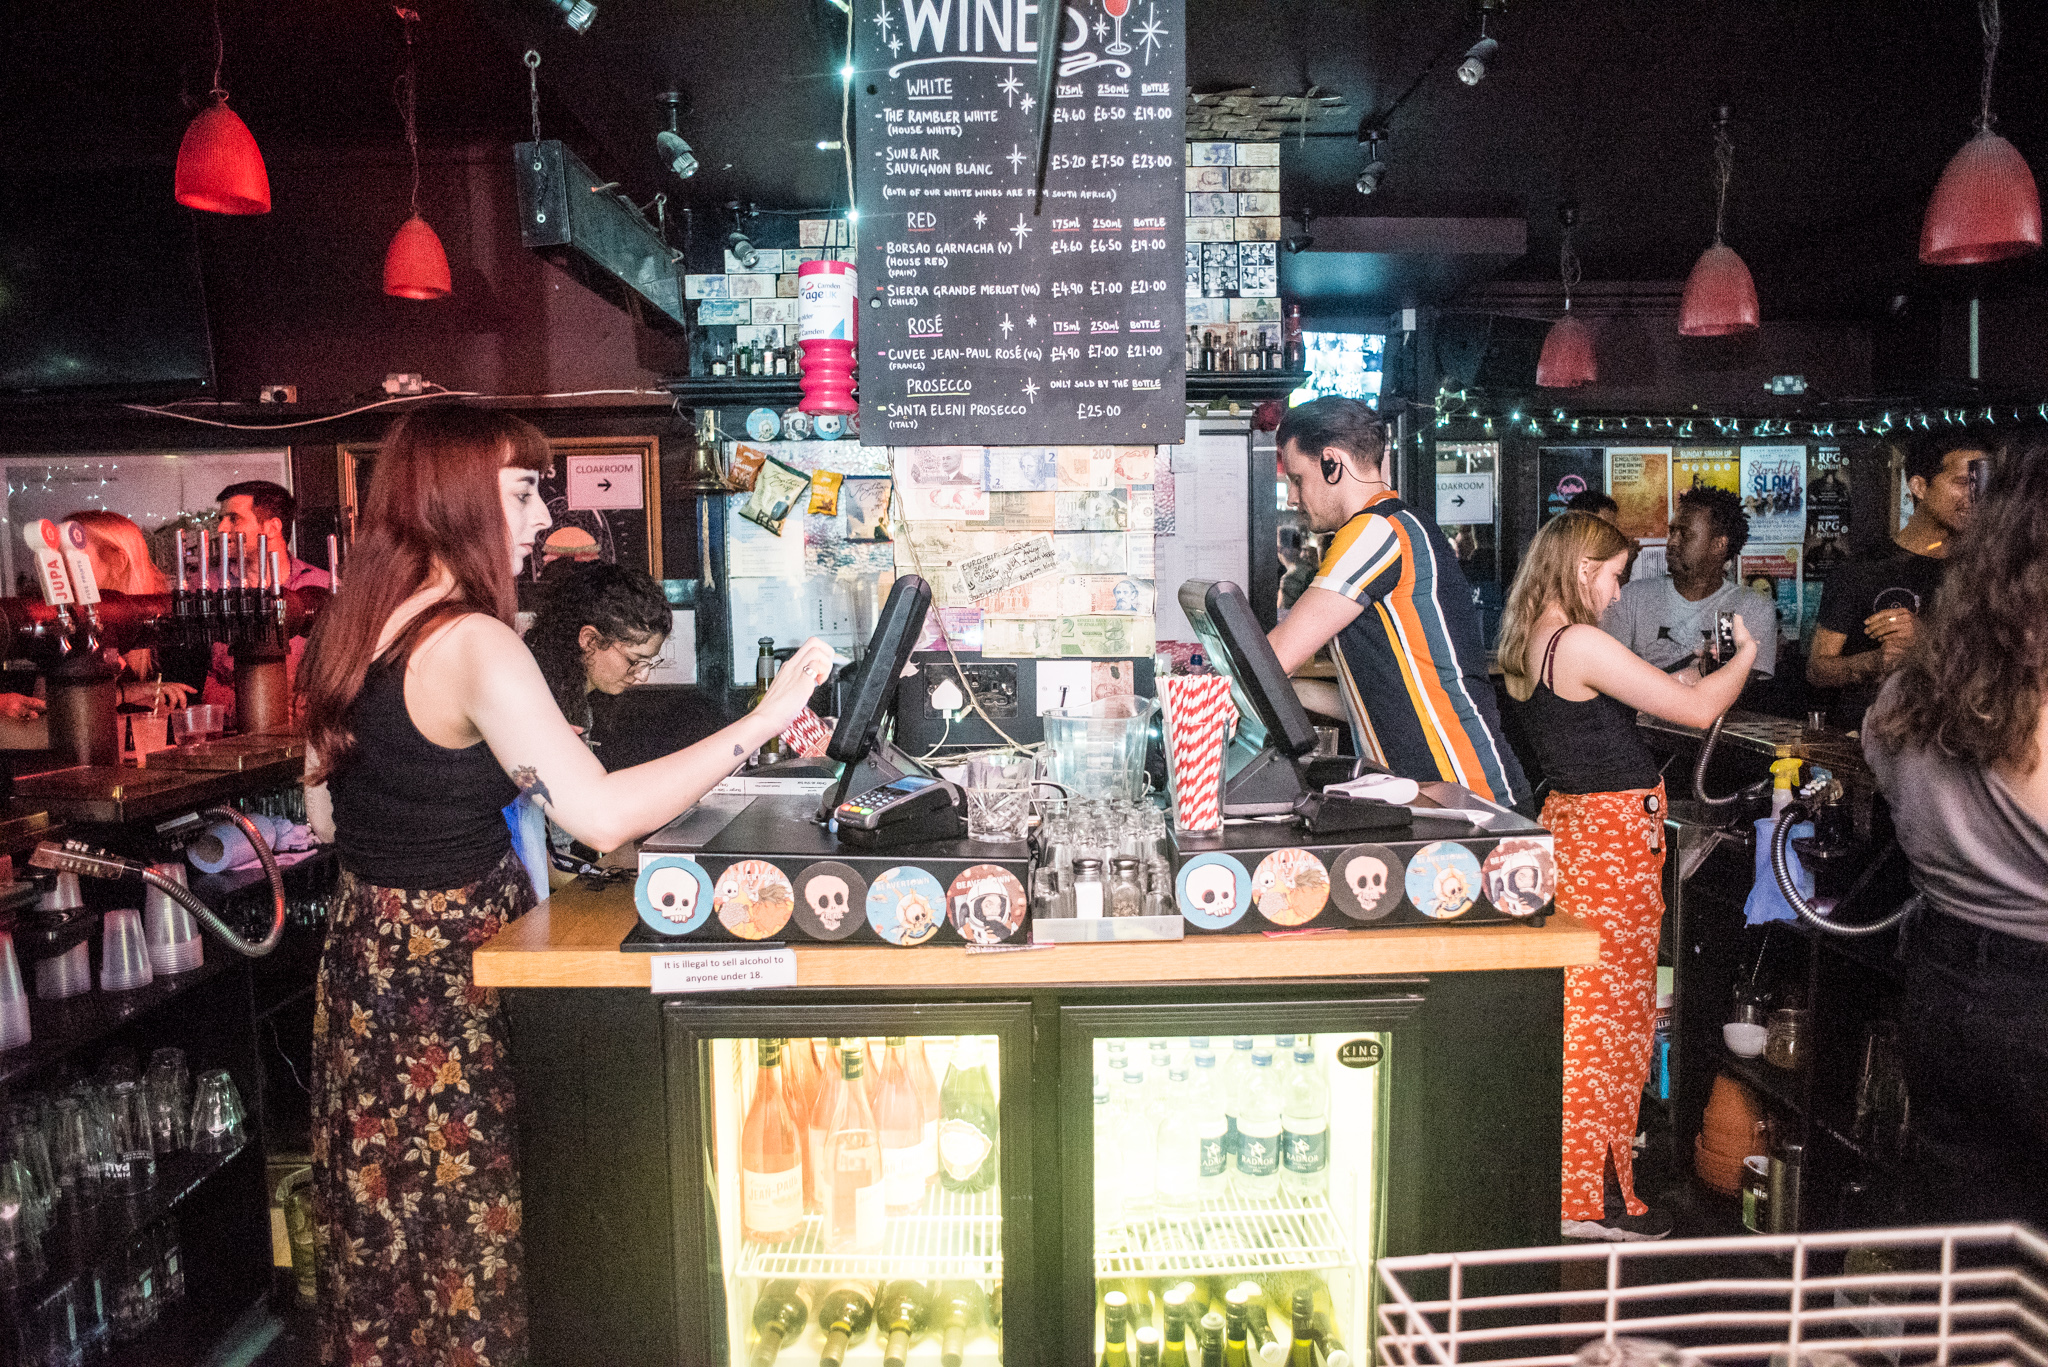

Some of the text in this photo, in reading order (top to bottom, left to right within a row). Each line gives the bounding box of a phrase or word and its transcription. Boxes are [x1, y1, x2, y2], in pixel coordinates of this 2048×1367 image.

[907, 78, 953, 95] WHITE
[1141, 83, 1170, 93] BOTTLE
[884, 109, 998, 124] THE RAMBLER WHITE
[887, 124, 962, 137] (HOUSE WHITE)
[886, 162, 993, 176] SAUVIGNON BLANC
[883, 185, 906, 198] (BOTH
[909, 189, 921, 197] OF
[924, 189, 941, 197] OUR
[944, 189, 972, 197] WHITE
[975, 189, 1002, 197] WINES
[1006, 189, 1024, 197] ARE
[1052, 189, 1077, 199] SOUTH
[1080, 188, 1117, 202] AFRICA)
[907, 213, 937, 228] RED
[1133, 218, 1166, 228] BOTTLE
[886, 242, 930, 254] BORSAO
[935, 242, 994, 254] GARNACHA
[886, 256, 948, 268] (HOUSE RED)
[888, 268, 917, 278] (SPAIN)
[805, 290, 837, 302] age UK
[887, 284, 1040, 297] SIERRA GRANDE MERLOT (VG)
[888, 297, 918, 307] (CHILE)
[908, 315, 944, 334] ROSÉ
[1129, 319, 1161, 330] BOTTLE
[888, 348, 926, 361] CUVEE
[930, 348, 992, 360] JEAN-PAUL
[995, 345, 1021, 360] ROSÉ
[889, 361, 925, 371] (FRANCE)
[907, 379, 972, 394] PROSECCO
[1050, 378, 1161, 389] ONLY SOLD BY THE BOTTLE
[887, 404, 1026, 417] SANTA ELENI PROSECCO
[889, 420, 918, 430] (ITALY)
[1048, 452, 1055, 462] 2
[1092, 449, 1112, 459] 200
[1680, 450, 1733, 459] SUNDAY SMASH UP
[1818, 452, 1840, 463] RPG
[575, 464, 633, 474] CLOAKROOM
[1748, 460, 1779, 477] Stand
[995, 478, 1000, 486] 2
[1754, 475, 1794, 492] SLAM
[1817, 521, 1840, 531] RPG
[48, 559, 68, 600] JUPA
[1061, 619, 1075, 638] 2
[876, 877, 930, 891] BEAVERTOWN
[664, 961, 670, 969] It
[673, 961, 680, 969] is
[682, 959, 708, 970] illegal
[722, 958, 737, 967] sell
[740, 957, 772, 965] alcohol
[774, 956, 784, 964] to
[686, 971, 763, 983] anyone under 18.
[1342, 1046, 1378, 1056] KING
[1241, 1156, 1274, 1166] RADNOR
[1286, 1152, 1319, 1163] RADNOR
[748, 1175, 798, 1201] JEAN-PAUL
